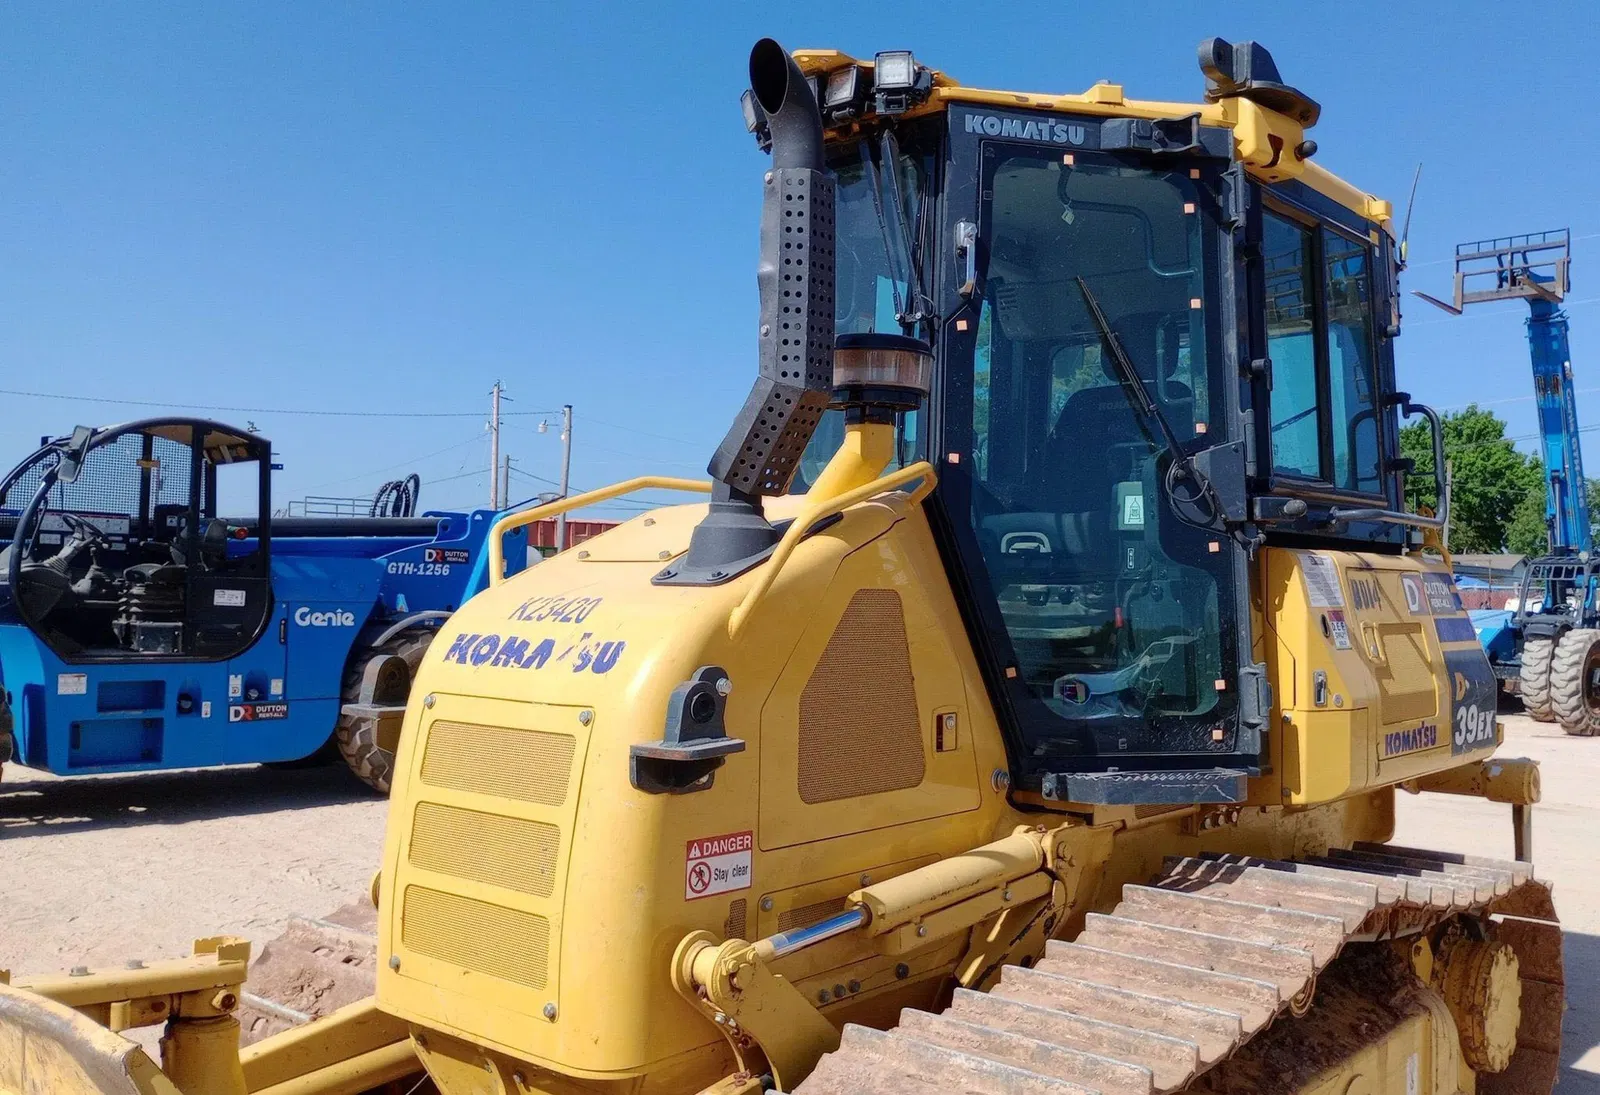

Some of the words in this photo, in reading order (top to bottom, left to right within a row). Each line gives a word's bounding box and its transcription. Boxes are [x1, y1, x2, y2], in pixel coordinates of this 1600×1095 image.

[965, 114, 1085, 145] KOMATSU
[387, 562, 450, 576] GTH-1256
[294, 606, 355, 627] Genie
[256, 705, 287, 713] DUTTON
[1455, 704, 1495, 745] 39EX
[1384, 720, 1437, 756] KOMATSU
[703, 835, 752, 856] DANGER
[713, 868, 729, 882] Stay
[732, 864, 749, 878] clear
